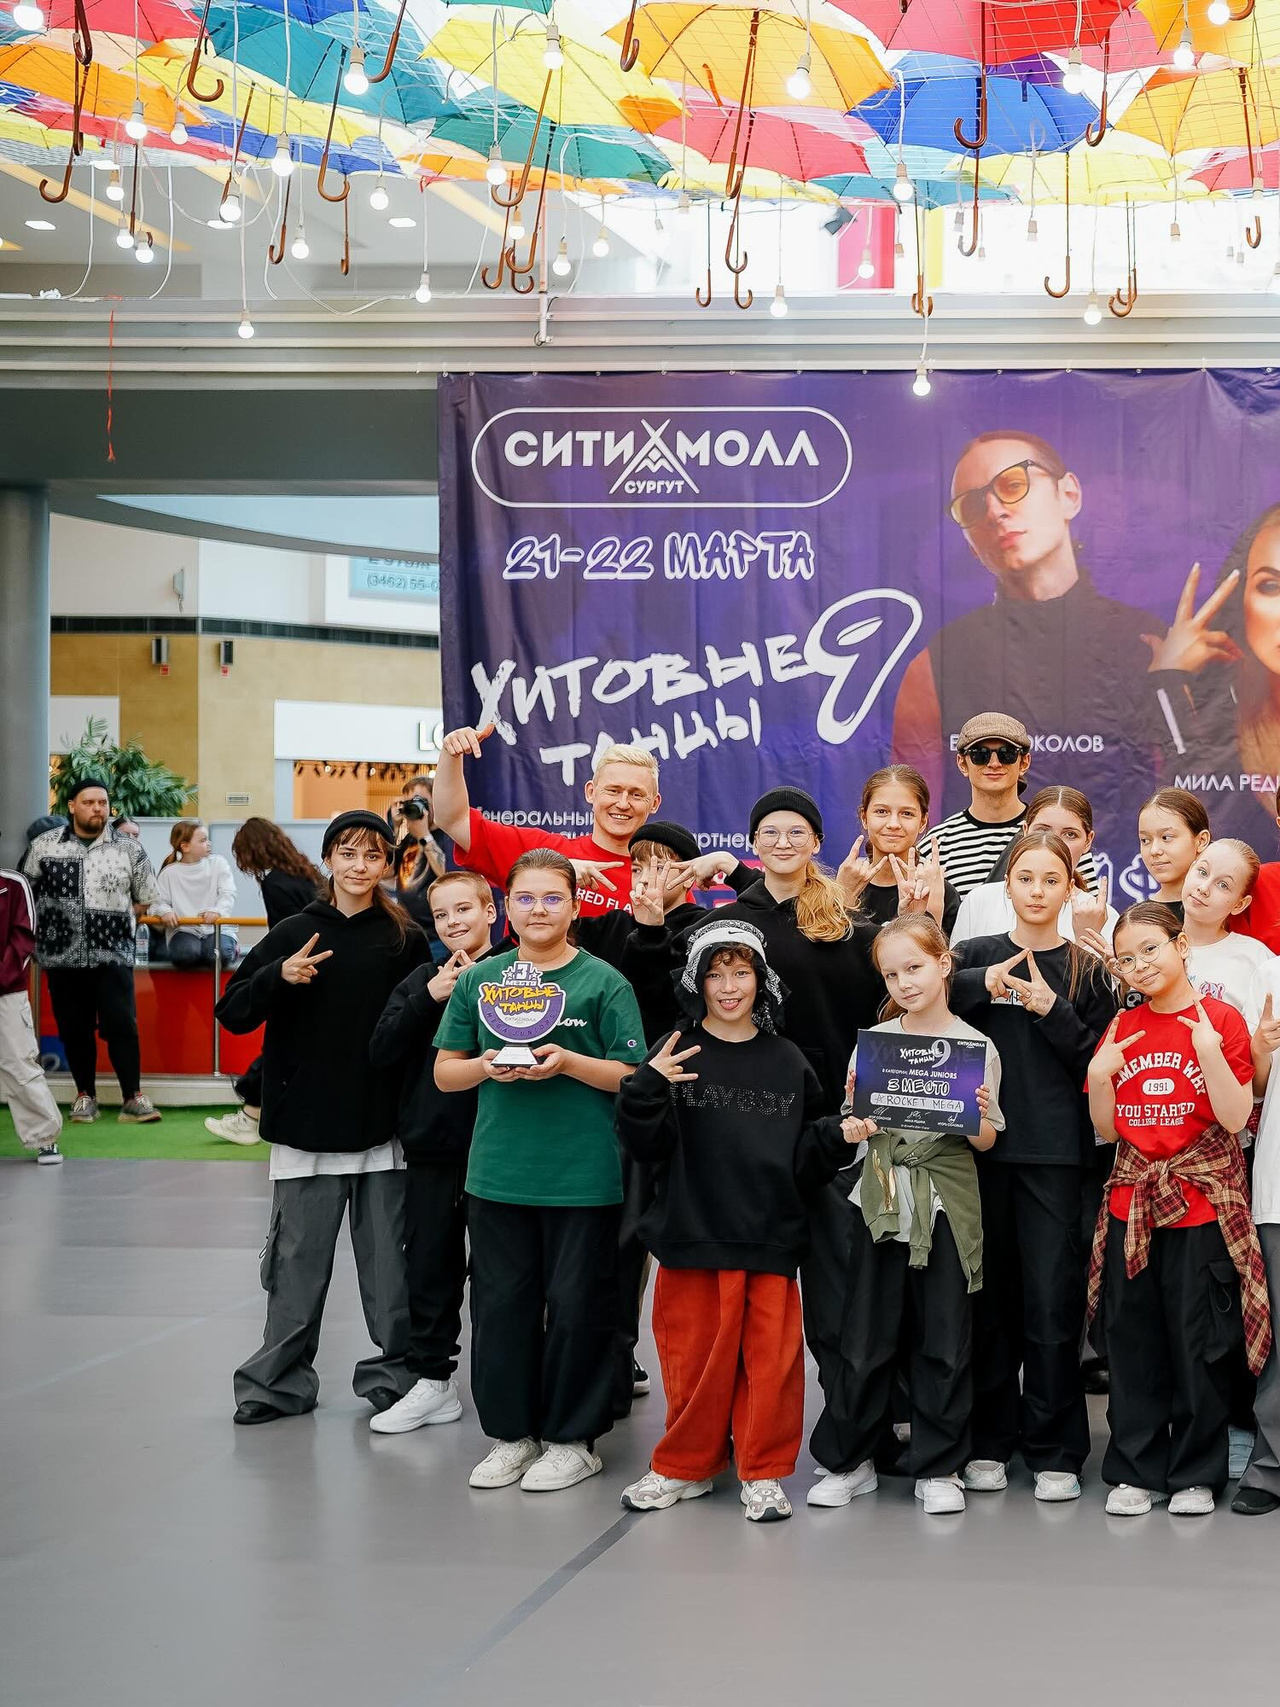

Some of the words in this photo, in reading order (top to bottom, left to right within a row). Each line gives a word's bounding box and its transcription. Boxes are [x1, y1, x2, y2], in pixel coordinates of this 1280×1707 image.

[623, 480, 685, 494] СУРГУТ
[502, 533, 655, 580] 21-22
[664, 529, 816, 581] МАРТА
[470, 634, 810, 746] ХИТОВЫЕ
[1029, 734, 1105, 753] КОЛОВ
[1173, 773, 1236, 791] МИЛА
[575, 887, 605, 906] RED
[516, 963, 529, 980] 3
[482, 985, 561, 1006] ХИТОВЫЕ
[499, 998, 545, 1013] ТАНЦЫ
[908, 1069, 929, 1077] MEGA
[930, 1071, 958, 1080] JUNIORS
[1116, 1051, 1183, 1090] MEMBER
[887, 1078, 900, 1092] 3
[933, 1100, 963, 1112] MEGA
[1116, 1104, 1142, 1118] YOU
